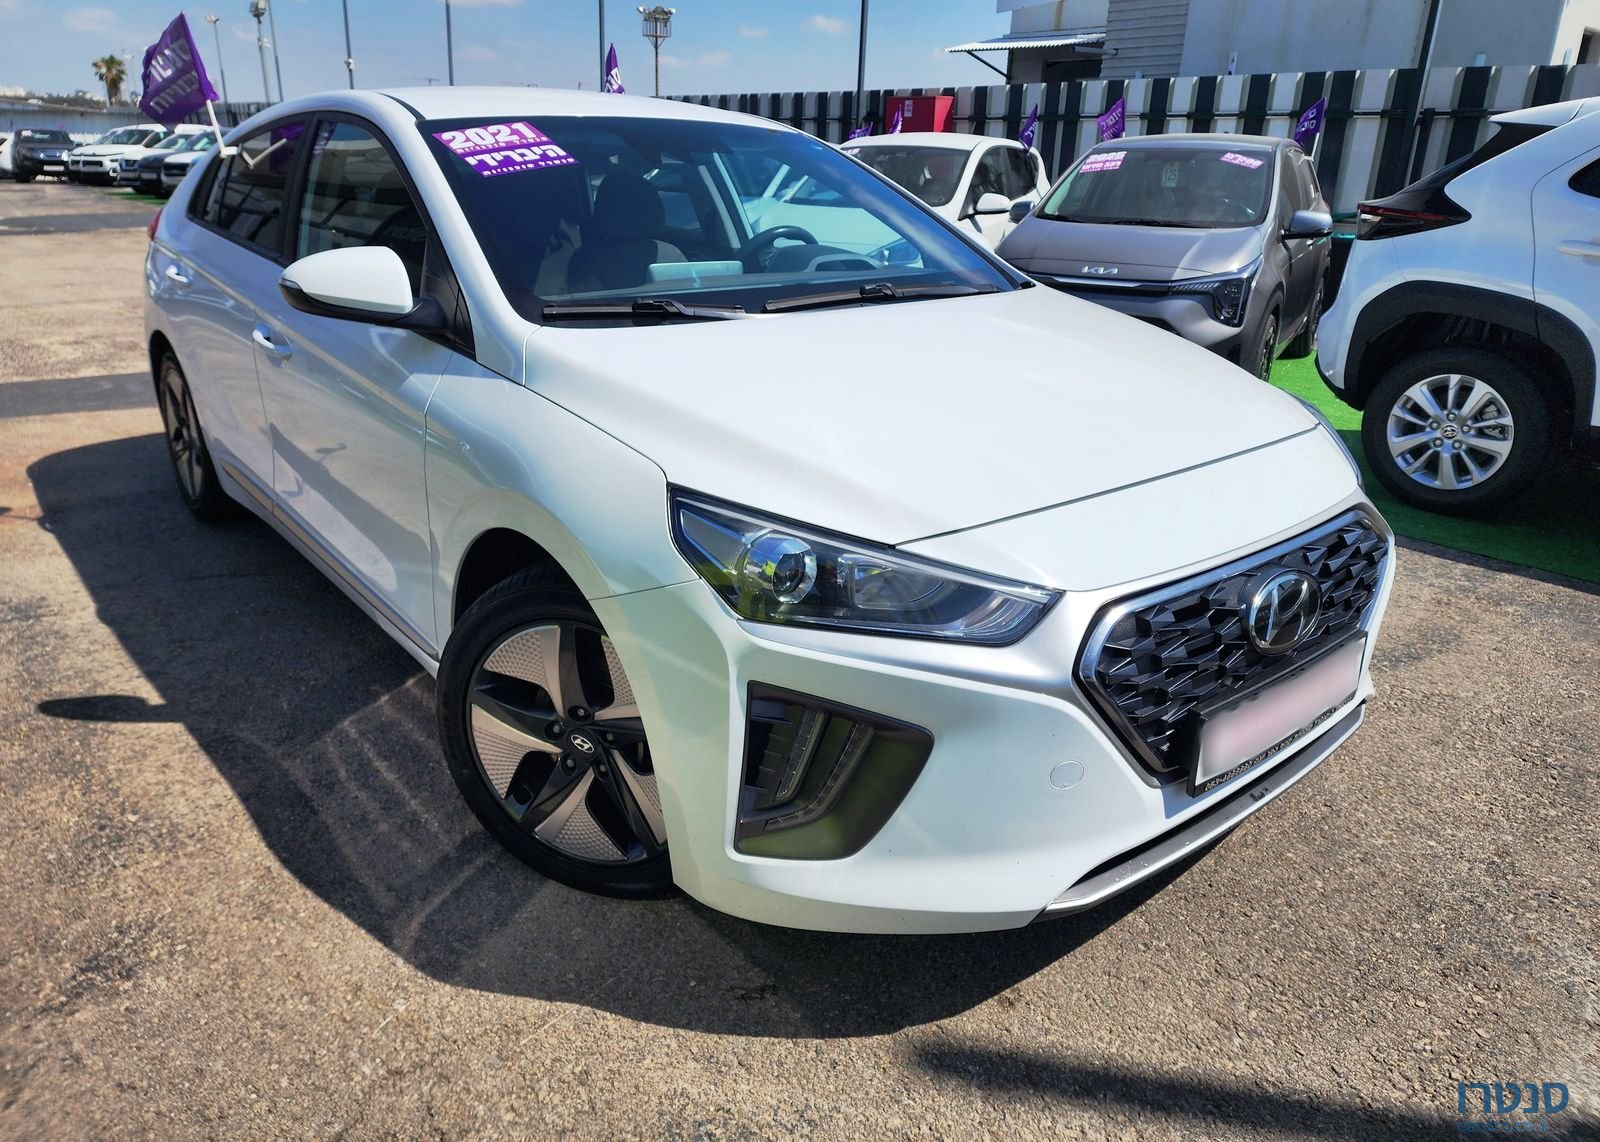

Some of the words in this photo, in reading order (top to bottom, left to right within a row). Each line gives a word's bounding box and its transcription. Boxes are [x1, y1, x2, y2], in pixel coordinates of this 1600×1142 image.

[441, 122, 536, 149] 2021
[464, 144, 567, 166] היברידי
[1081, 265, 1118, 275] KIA
